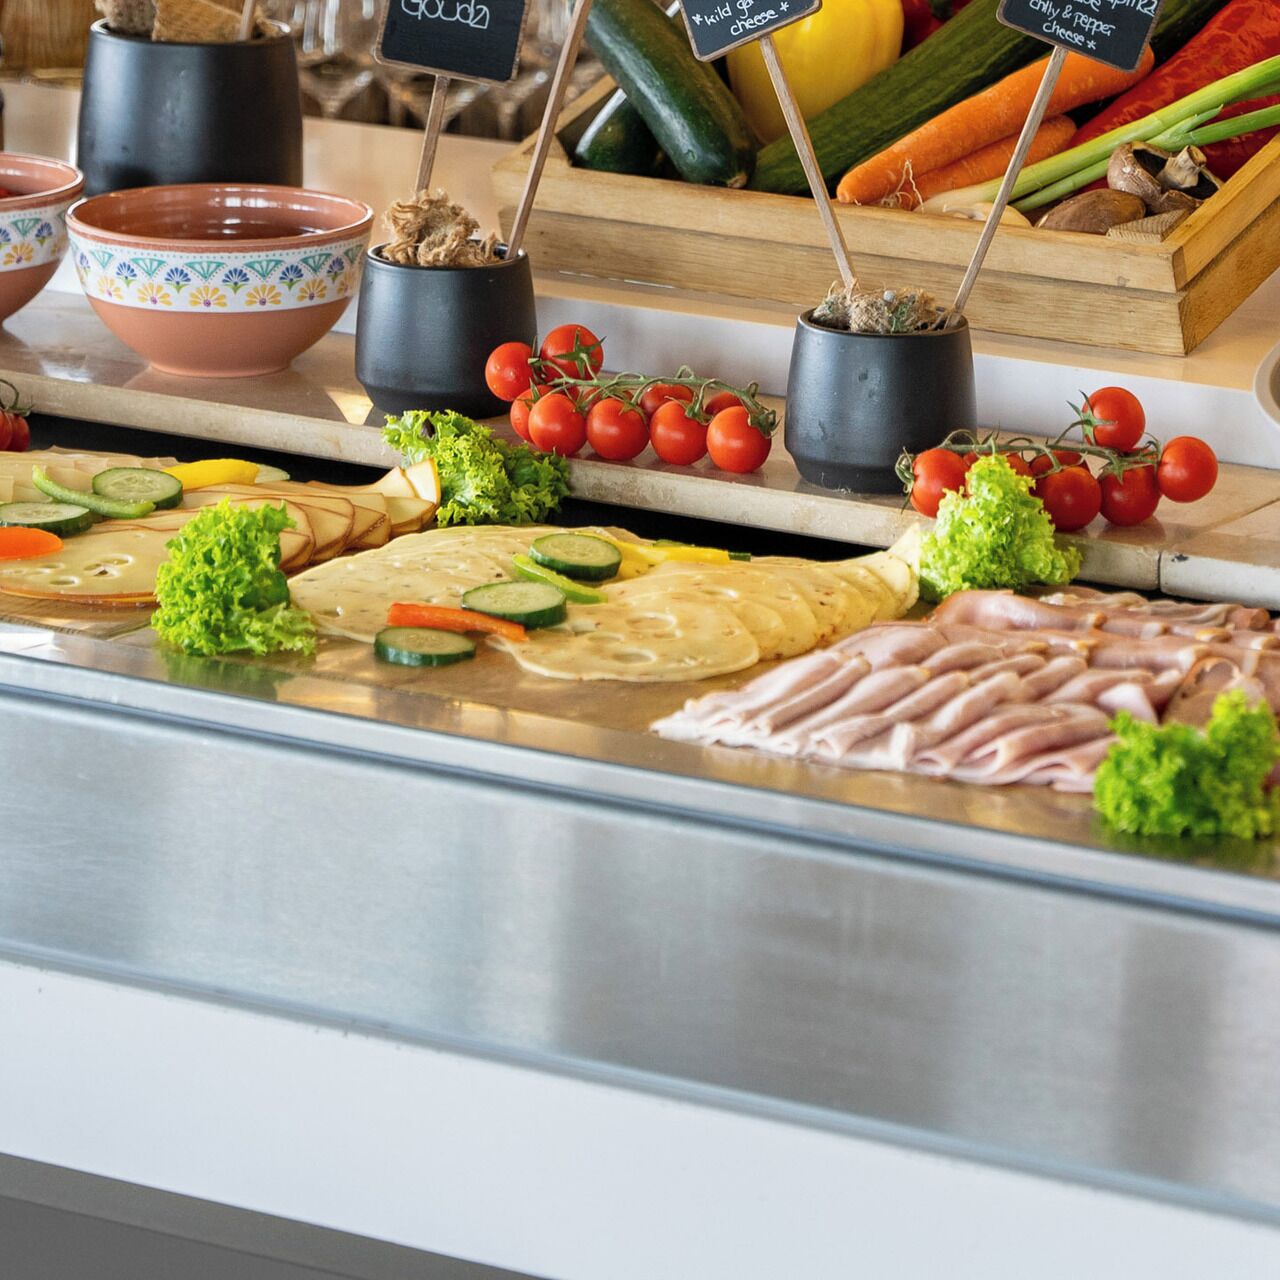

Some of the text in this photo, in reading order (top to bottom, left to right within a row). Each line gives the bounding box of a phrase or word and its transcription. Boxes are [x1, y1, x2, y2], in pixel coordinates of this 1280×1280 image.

[730, 9, 779, 36] cheese
[1042, 21, 1085, 46] cheese
[1062, 4, 1073, 19] &
[1073, 11, 1116, 37] pepper
